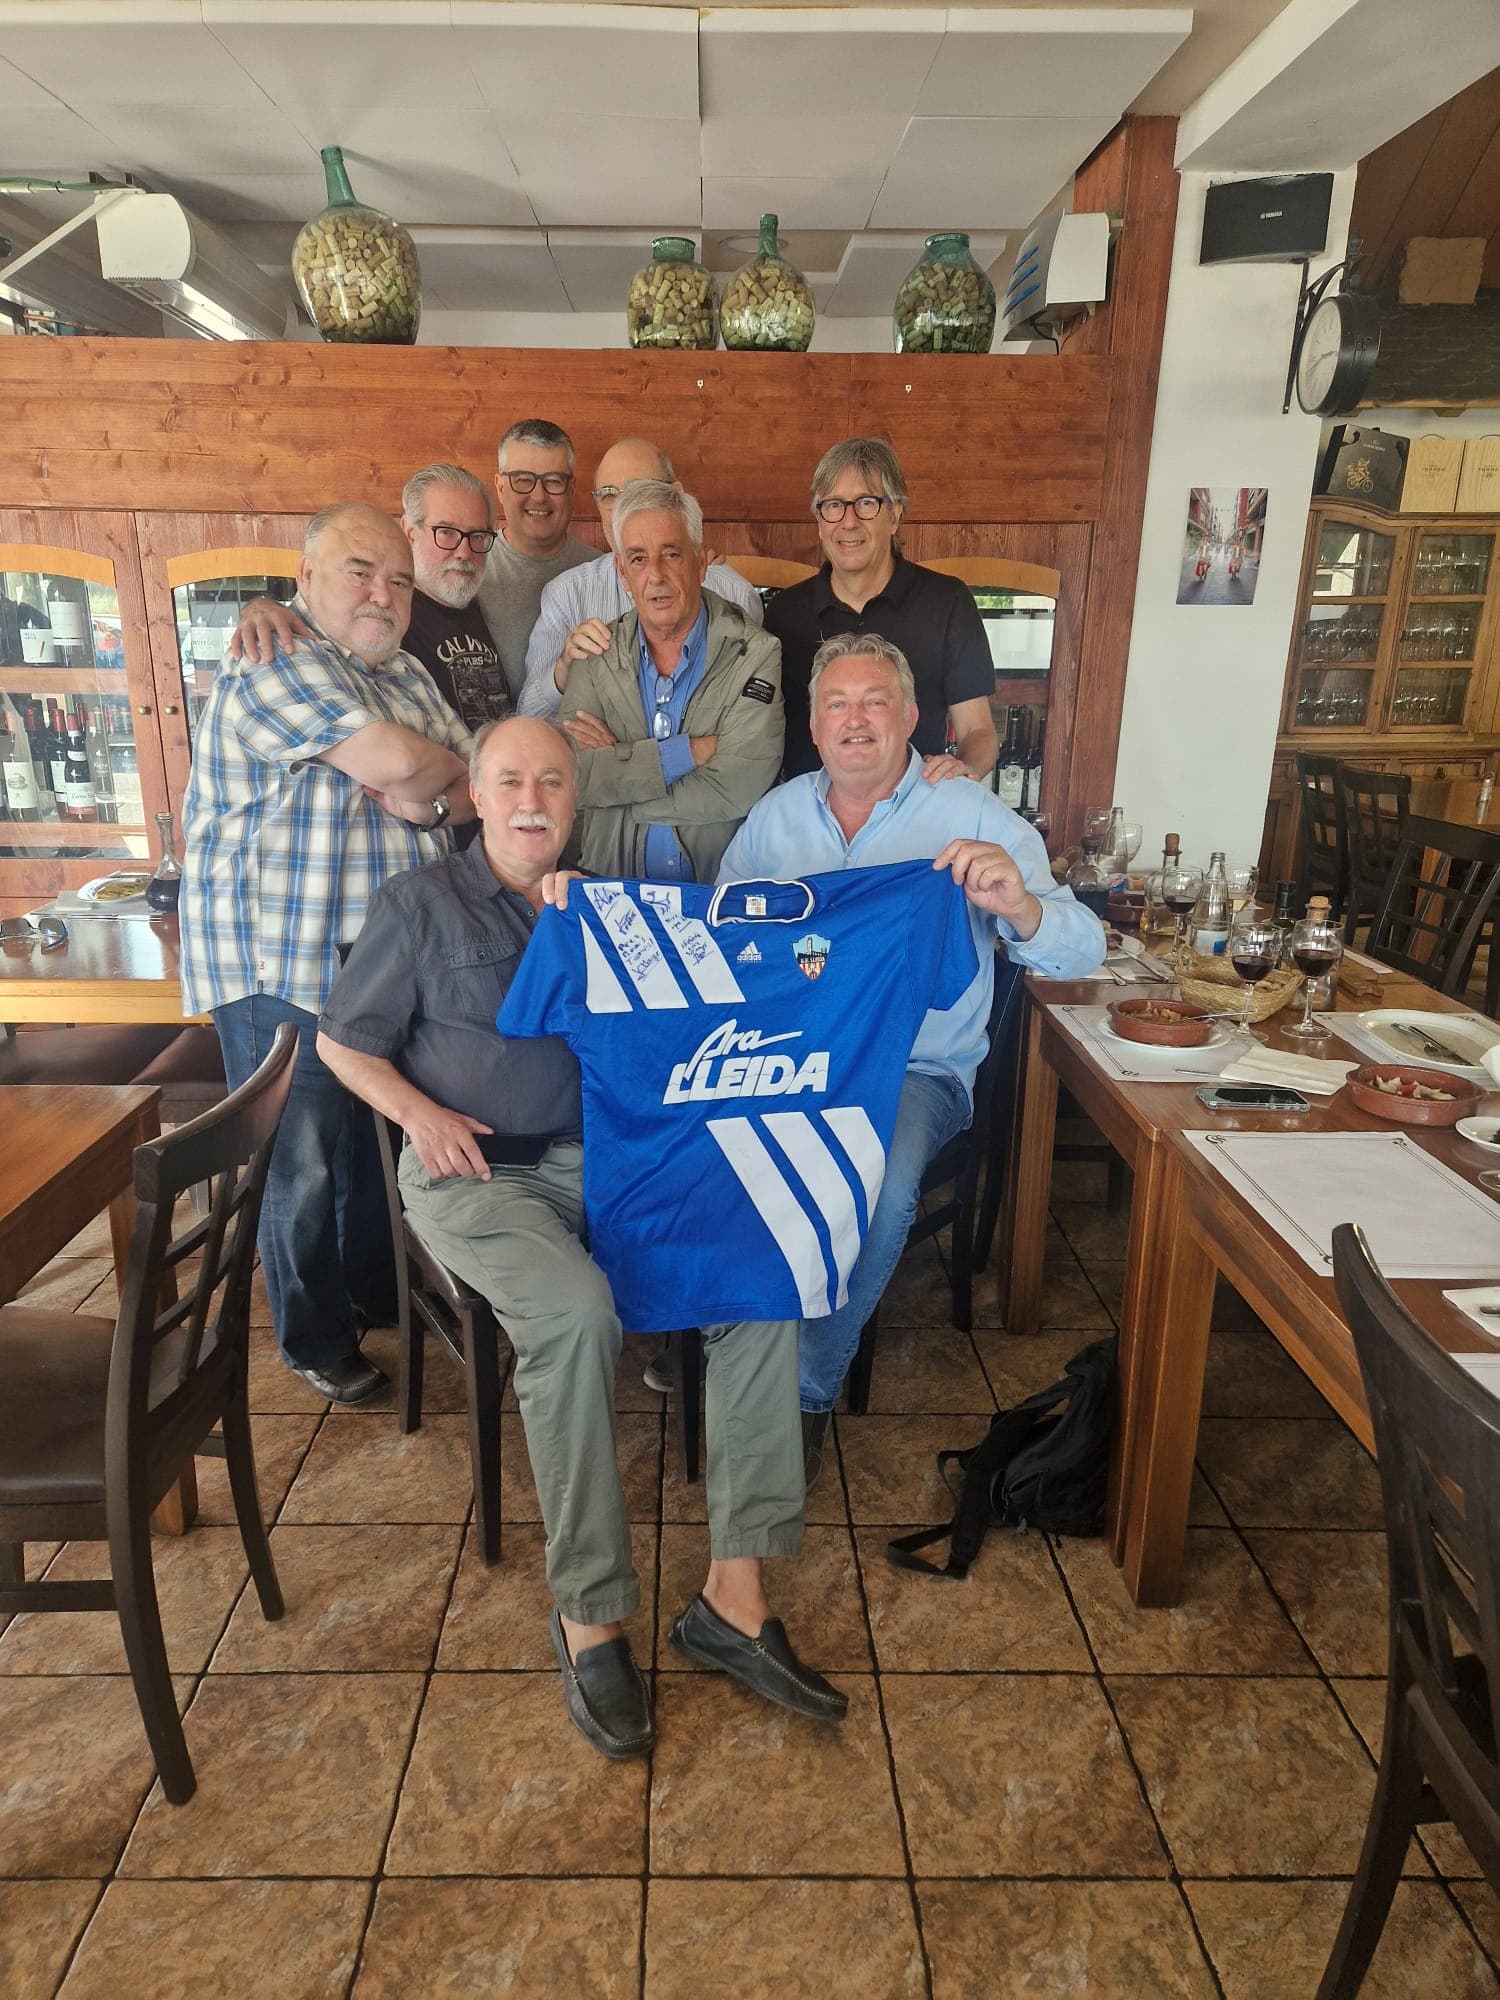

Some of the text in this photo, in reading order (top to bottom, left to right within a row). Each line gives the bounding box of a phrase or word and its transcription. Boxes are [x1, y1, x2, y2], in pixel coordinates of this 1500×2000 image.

[463, 656, 484, 666] PUBS
[736, 951, 762, 961] adidas
[682, 1018, 804, 1081] Ara
[662, 1051, 830, 1105] LLEIDA
